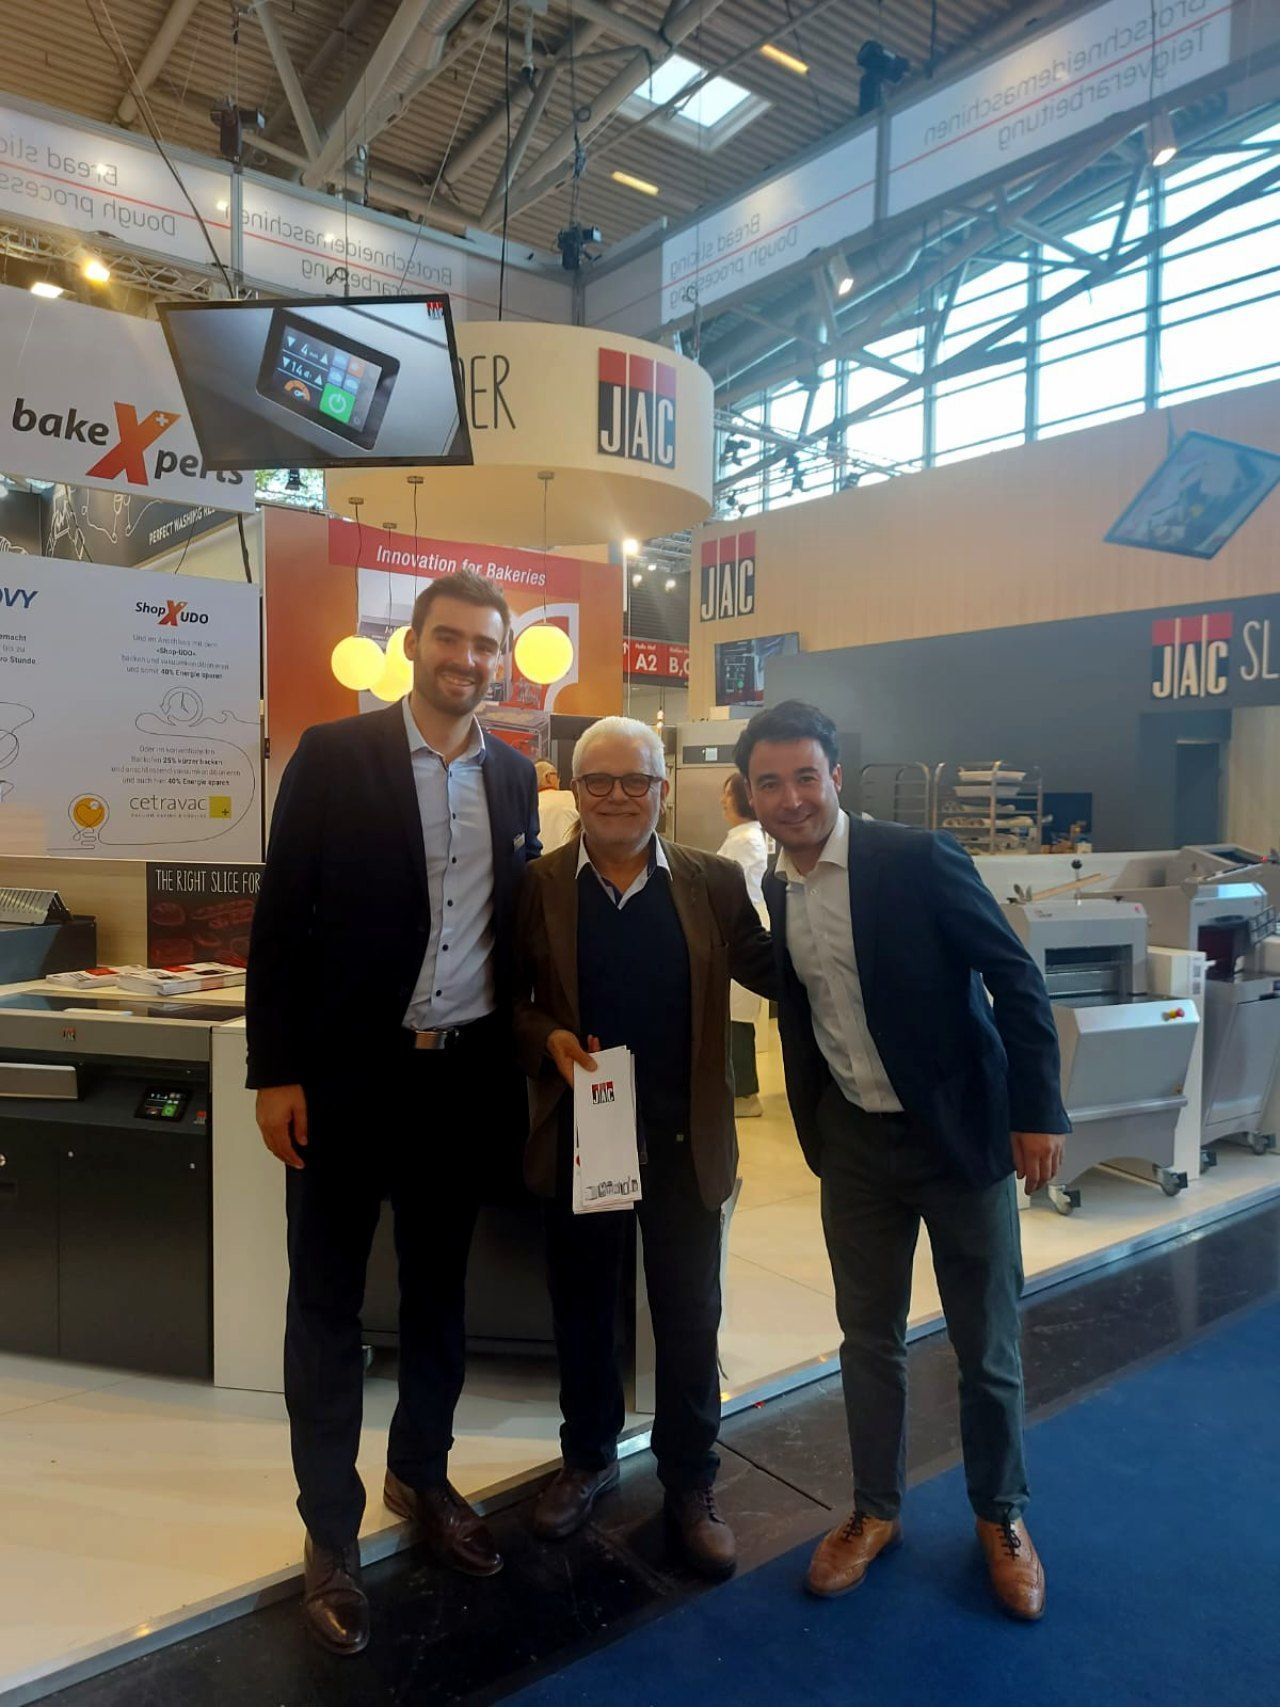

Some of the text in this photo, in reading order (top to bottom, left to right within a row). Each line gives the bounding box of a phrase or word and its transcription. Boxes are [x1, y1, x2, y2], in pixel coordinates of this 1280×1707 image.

[457, 354, 517, 430] ER
[600, 384, 674, 466] JAC
[149, 521, 174, 546] PERFECT
[174, 507, 202, 532] WASHING
[376, 544, 457, 574] Innovation
[486, 562, 547, 587] Bakeries
[0, 587, 40, 608] VY
[701, 558, 754, 621] JAC
[635, 653, 658, 672] A2
[1151, 640, 1228, 698] JAC
[129, 794, 207, 811] cetravac
[155, 868, 261, 894] THE RIGHT SLICE FOR
